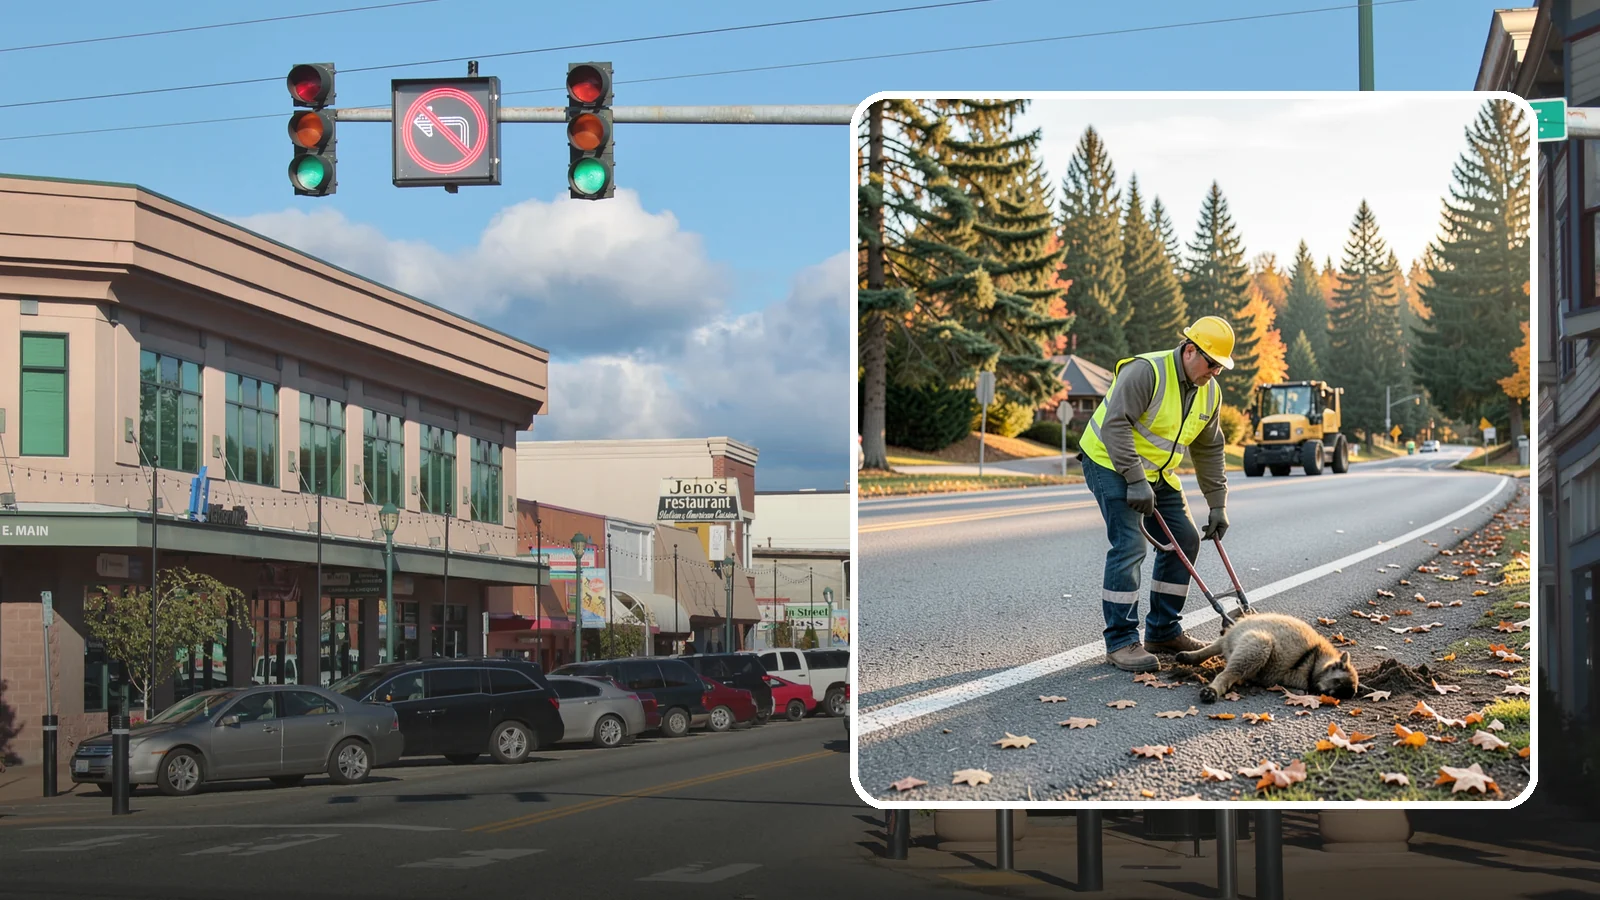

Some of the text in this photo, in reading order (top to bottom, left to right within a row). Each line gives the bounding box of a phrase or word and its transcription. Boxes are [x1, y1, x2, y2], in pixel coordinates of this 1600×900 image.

[669, 480, 727, 494] Jeno's
[665, 496, 731, 509] restaurant
[659, 510, 682, 520] Italian
[686, 510, 714, 519] American
[715, 509, 737, 519] Cuisine
[2, 525, 49, 536] E. MAIN
[797, 607, 828, 616] Street
